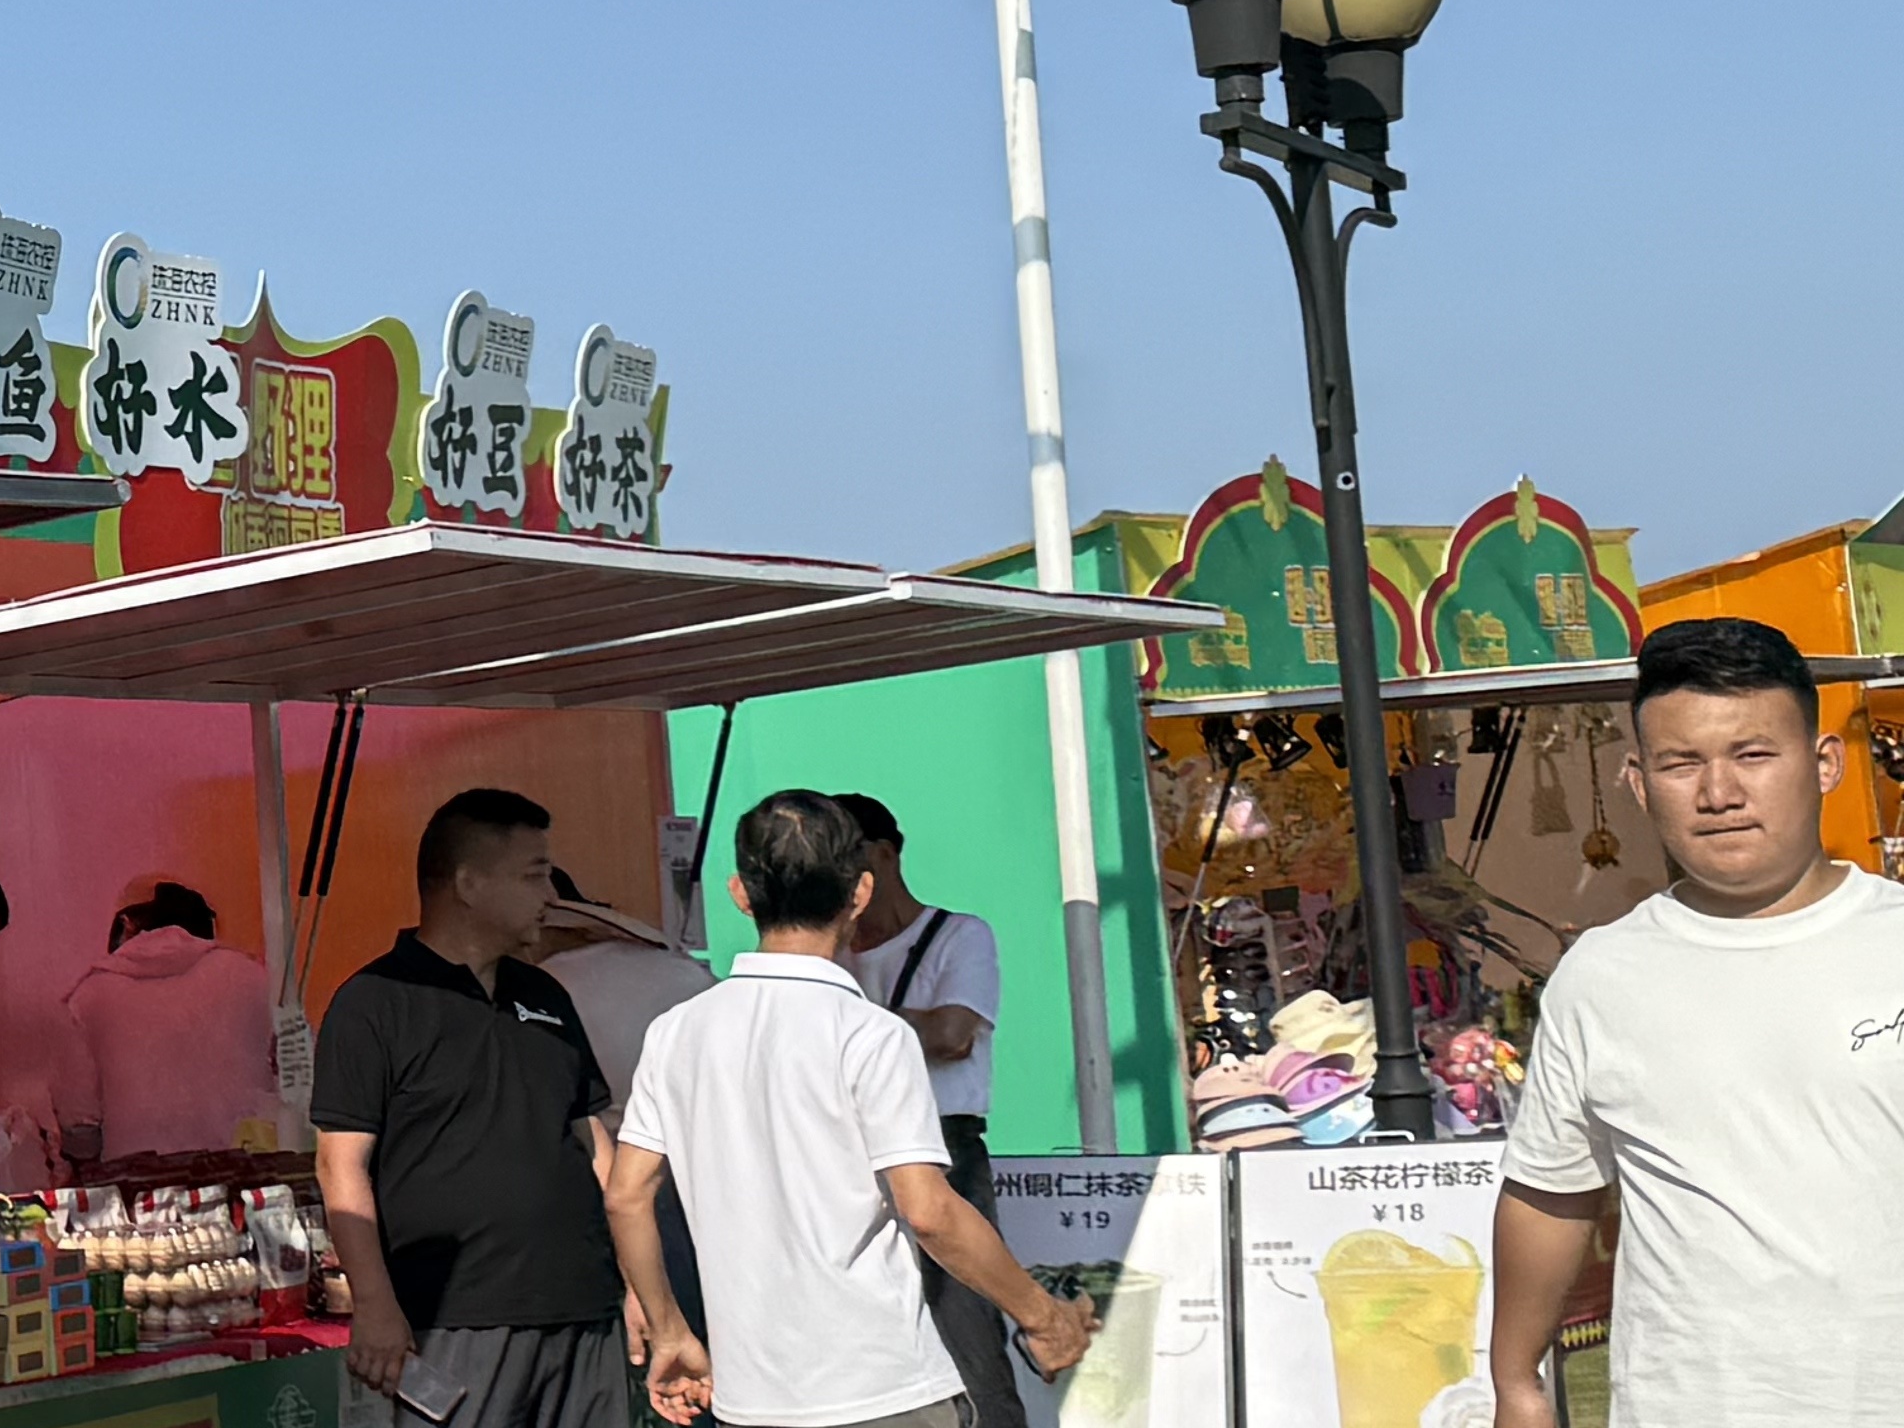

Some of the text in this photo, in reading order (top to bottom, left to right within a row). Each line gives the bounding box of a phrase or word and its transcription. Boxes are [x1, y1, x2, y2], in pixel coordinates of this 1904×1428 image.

[150, 299, 216, 326] ZHNK
[93, 338, 237, 463] 好水
[427, 383, 523, 500] 好豆
[563, 416, 648, 522] 好茶
